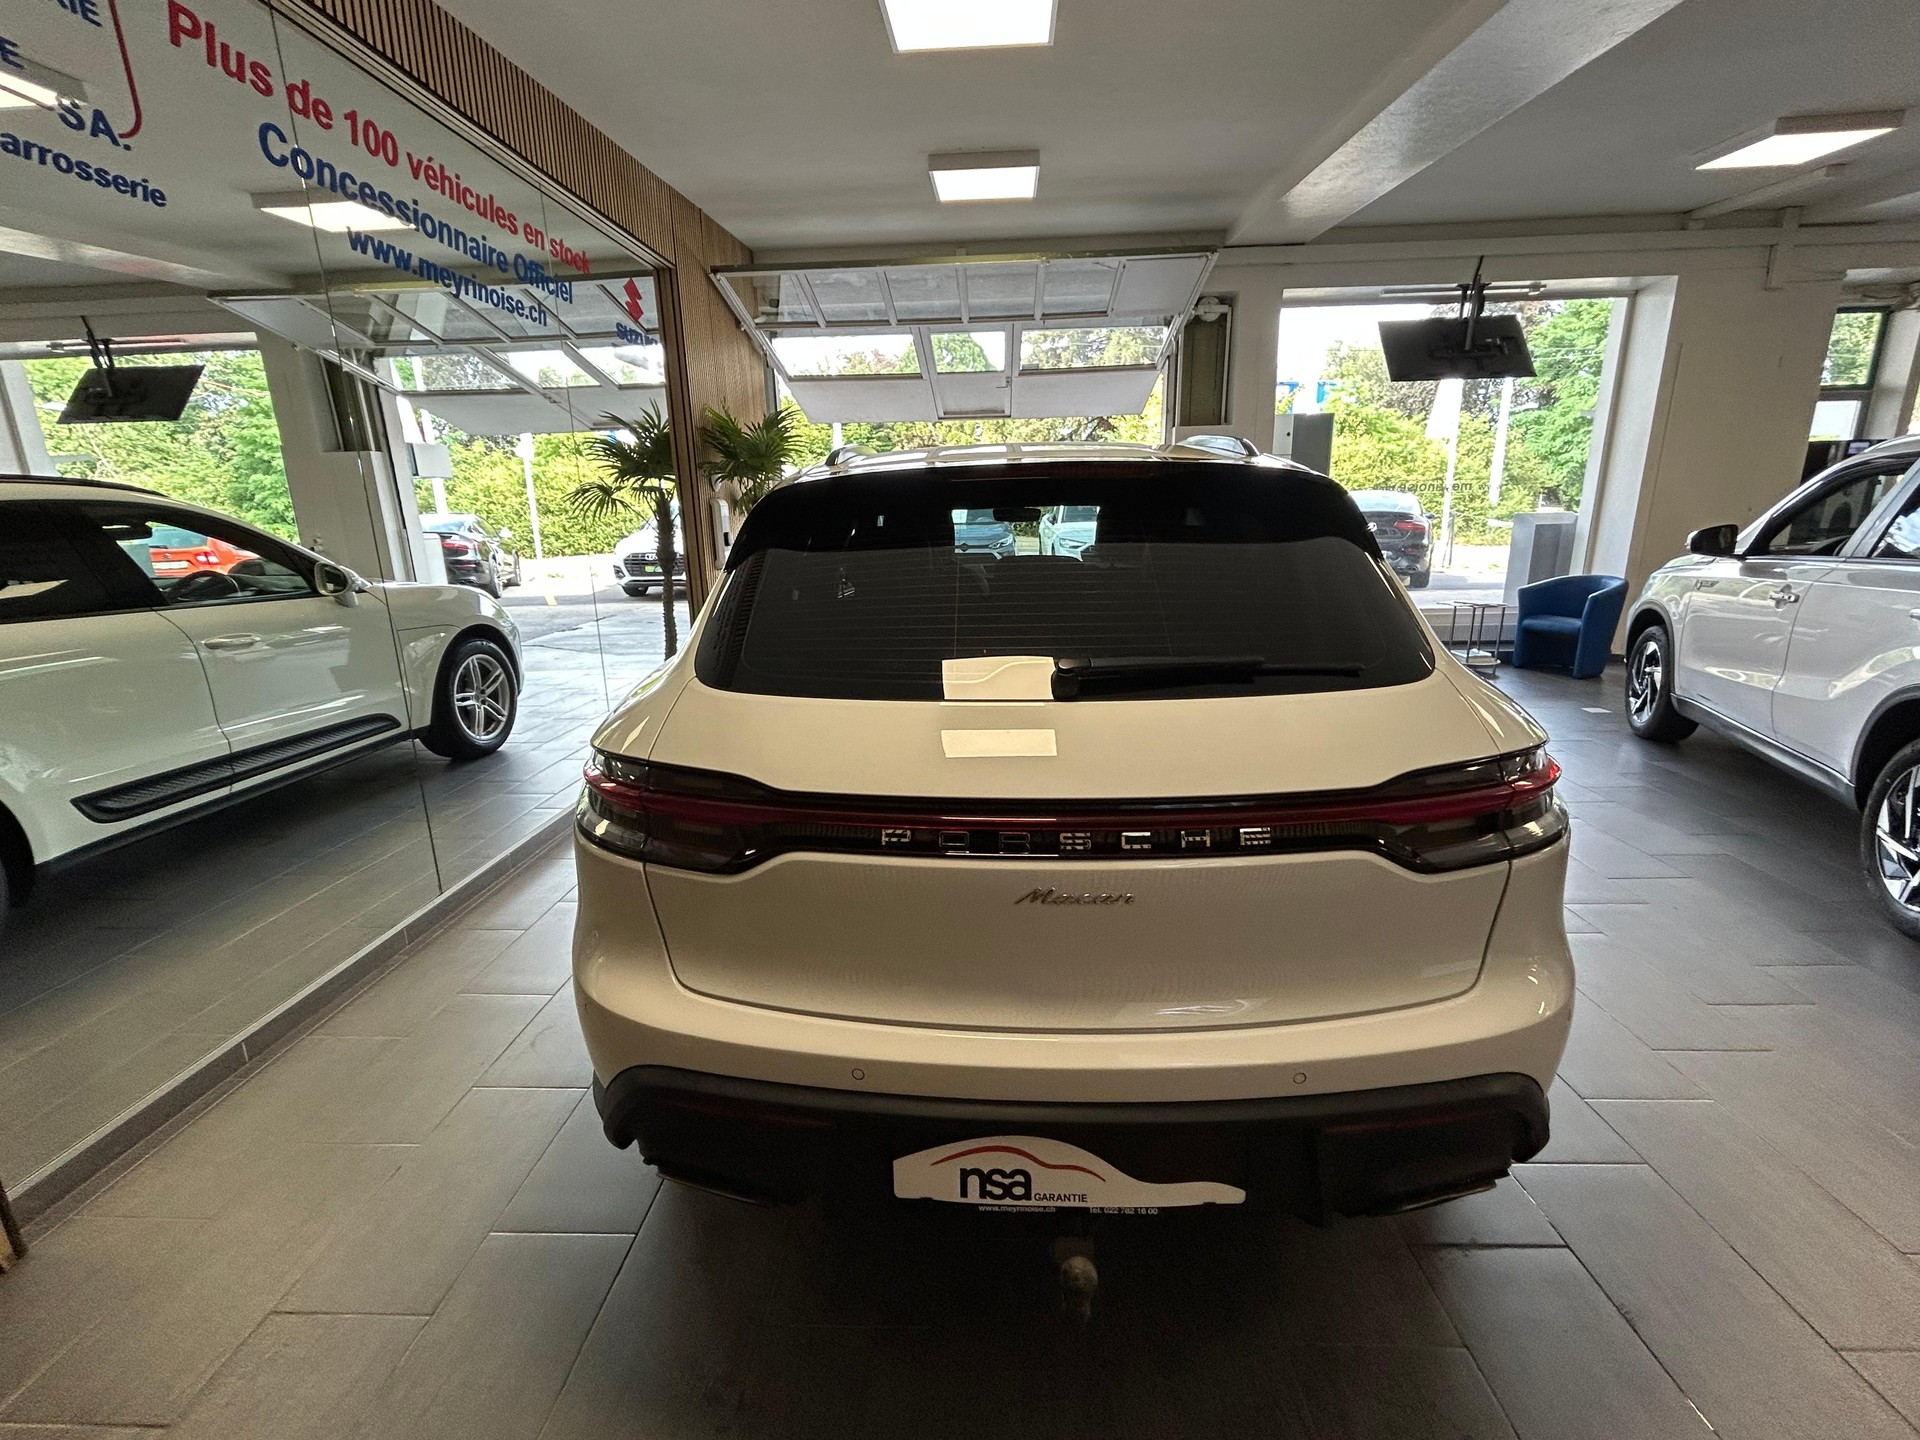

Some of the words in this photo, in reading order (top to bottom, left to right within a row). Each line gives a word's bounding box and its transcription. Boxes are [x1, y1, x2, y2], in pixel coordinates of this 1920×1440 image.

[55, 94, 132, 150] SA.
[167, 0, 274, 97] Plus
[285, 80, 334, 130] de
[344, 109, 399, 168] 100
[407, 150, 519, 235] véhicules
[523, 222, 546, 251] en
[550, 237, 591, 275] stock
[258, 122, 509, 273] Concessionnaire
[513, 253, 573, 304] Officiel
[346, 226, 548, 326] www.meyrinoise.ch
[881, 827, 1271, 852] PORSCHE
[1014, 887, 1134, 905] Macan
[959, 1167, 1032, 1201] nsa
[1034, 1193, 1087, 1203] GARANTIE
